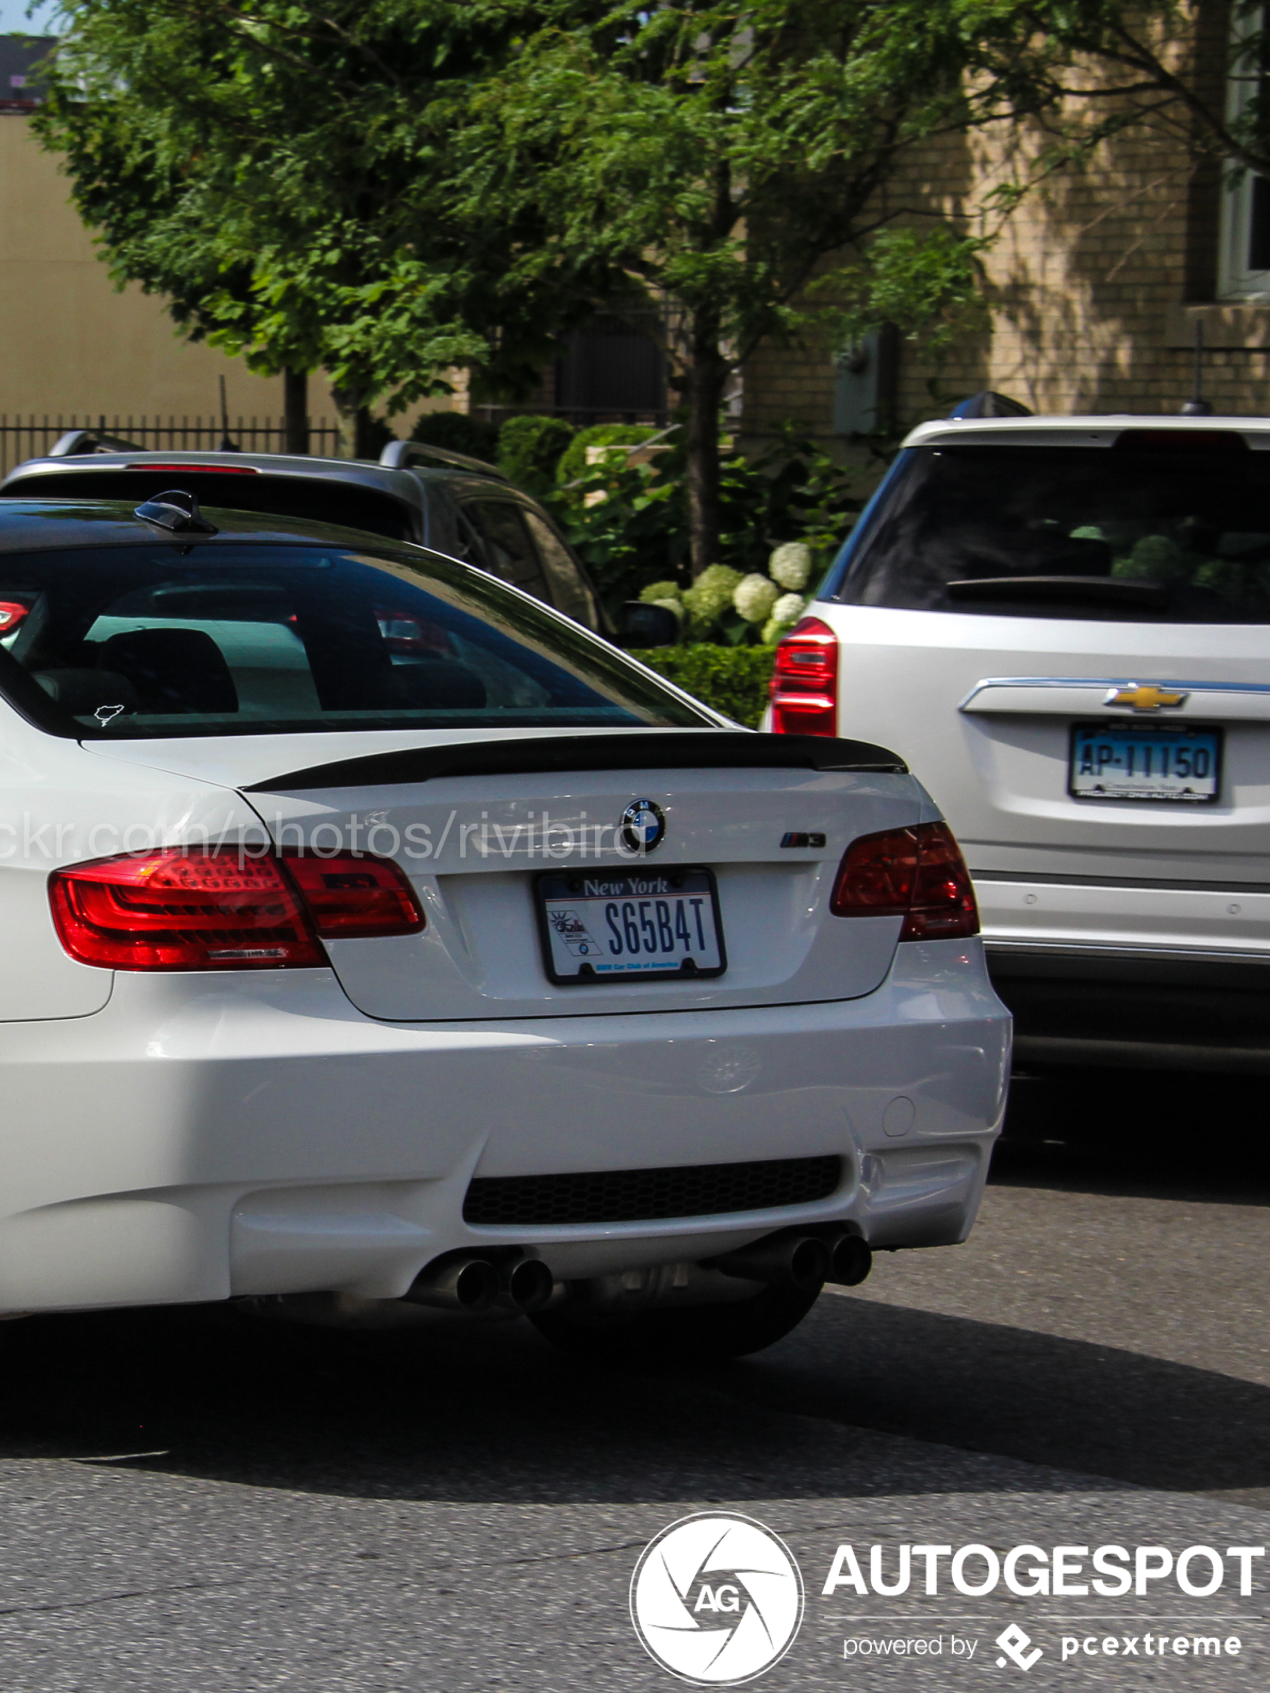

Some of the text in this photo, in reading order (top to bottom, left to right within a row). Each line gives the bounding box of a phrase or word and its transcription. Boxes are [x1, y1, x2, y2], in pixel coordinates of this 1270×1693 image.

[583, 877, 668, 896] New York
[605, 899, 706, 955] S65B4T
